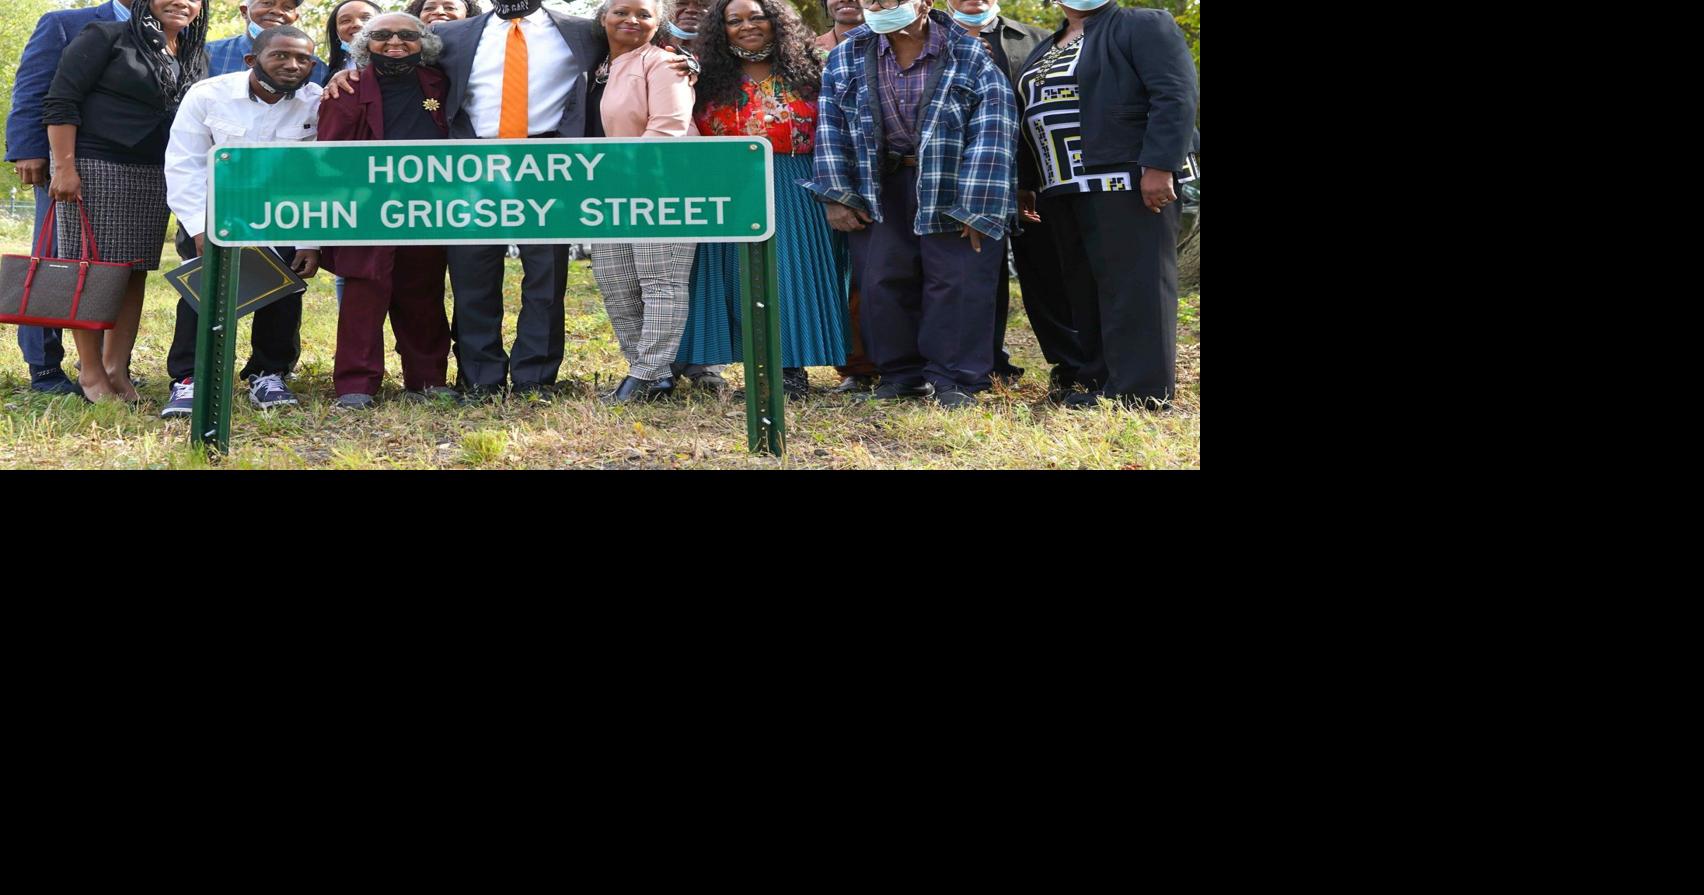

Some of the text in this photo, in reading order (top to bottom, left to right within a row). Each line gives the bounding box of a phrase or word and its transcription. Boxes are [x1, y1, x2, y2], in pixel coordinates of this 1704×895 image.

[368, 153, 605, 183] HONORARY
[249, 196, 731, 229] JOHN GRIGSBY STREET
